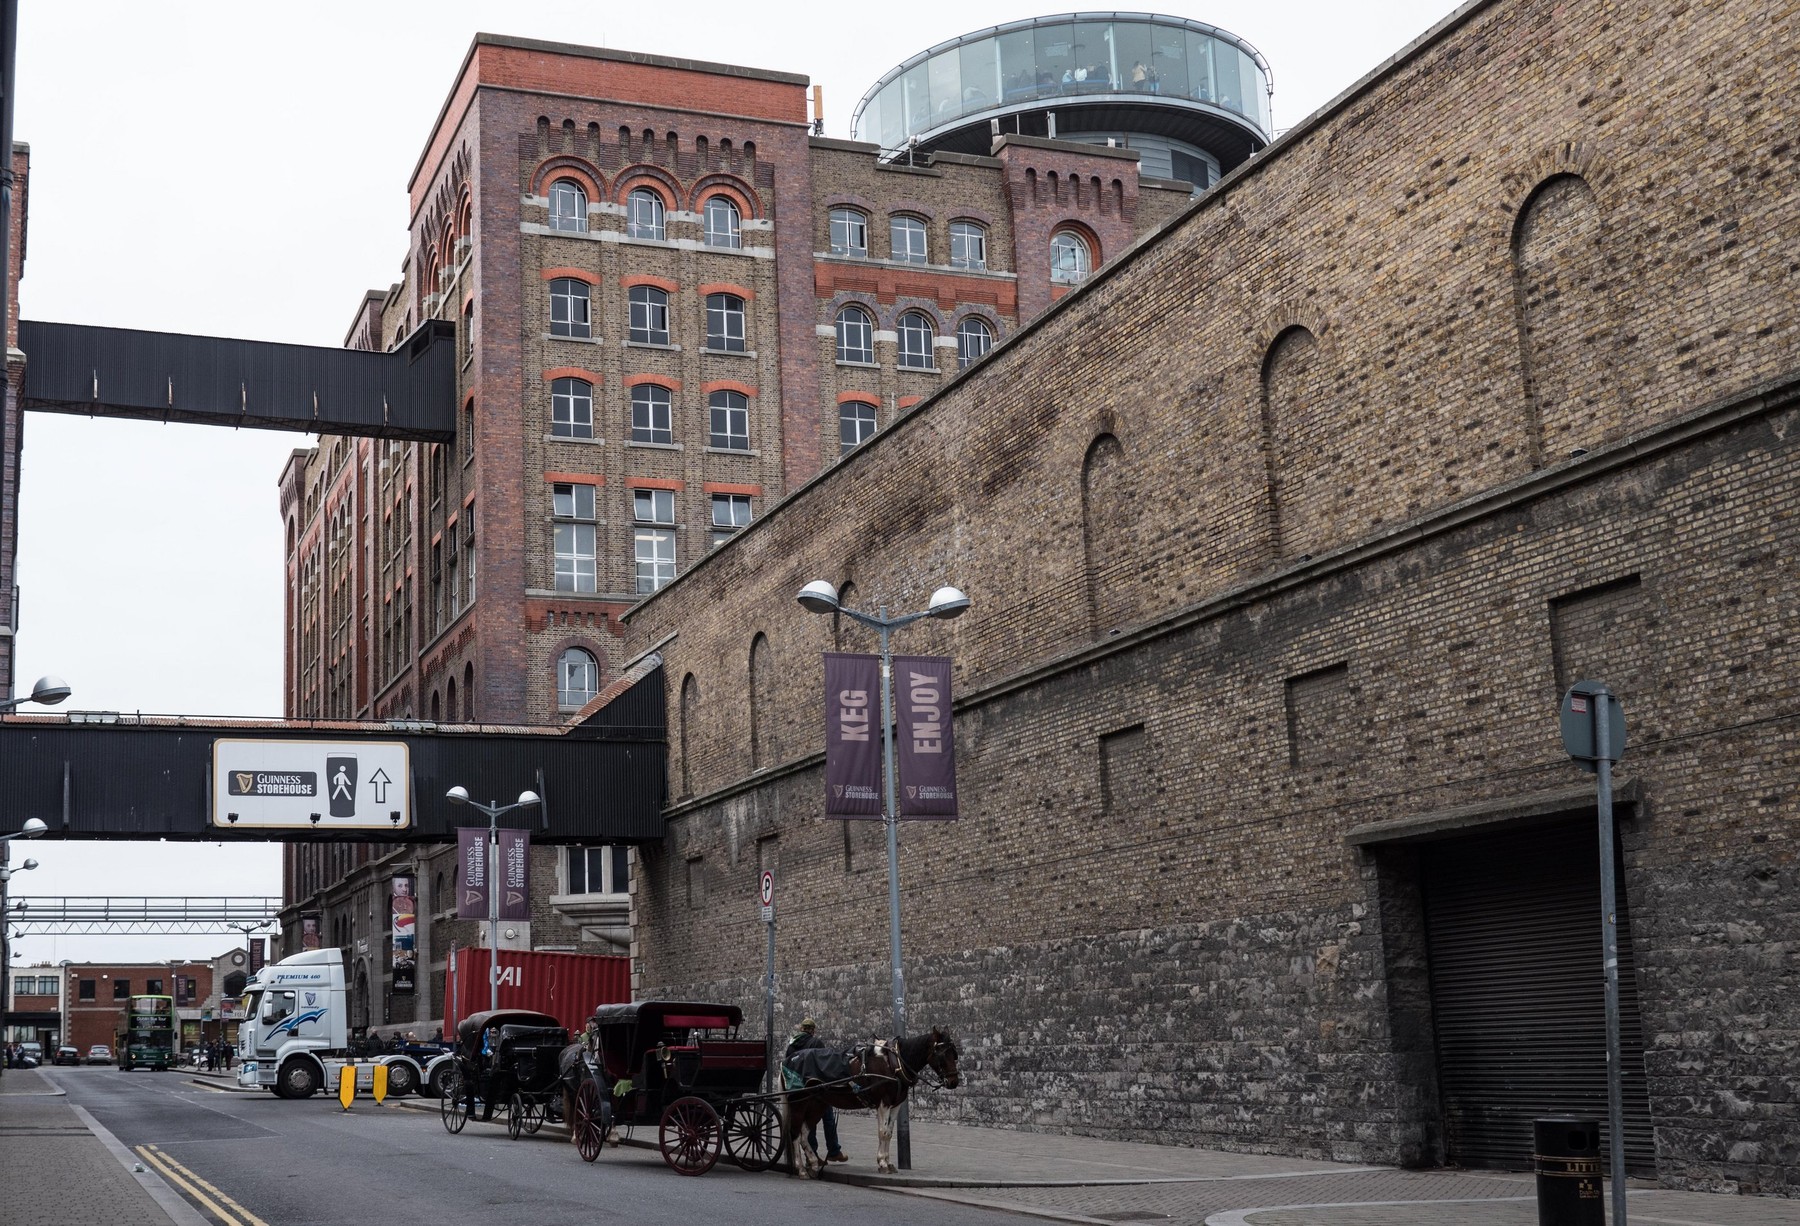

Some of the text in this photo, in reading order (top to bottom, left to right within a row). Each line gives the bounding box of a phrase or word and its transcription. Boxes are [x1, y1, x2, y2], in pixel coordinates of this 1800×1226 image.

[840, 690, 869, 742] KEG
[910, 671, 942, 754] ENJOY
[257, 773, 301, 784] GUINNESS
[257, 784, 312, 795] STOREHOUSE
[845, 785, 873, 793] GUINNESS
[919, 785, 948, 793] GUINNESS
[845, 791, 879, 800] STOREHOUSE
[919, 792, 954, 800] STOREHOUSE
[465, 846, 475, 887] GUINNESS
[474, 836, 484, 887] STOREHOUSE
[515, 837, 524, 888] STOREHOUSE
[506, 847, 516, 888] GUINNESS
[277, 974, 309, 984] PREMIUM
